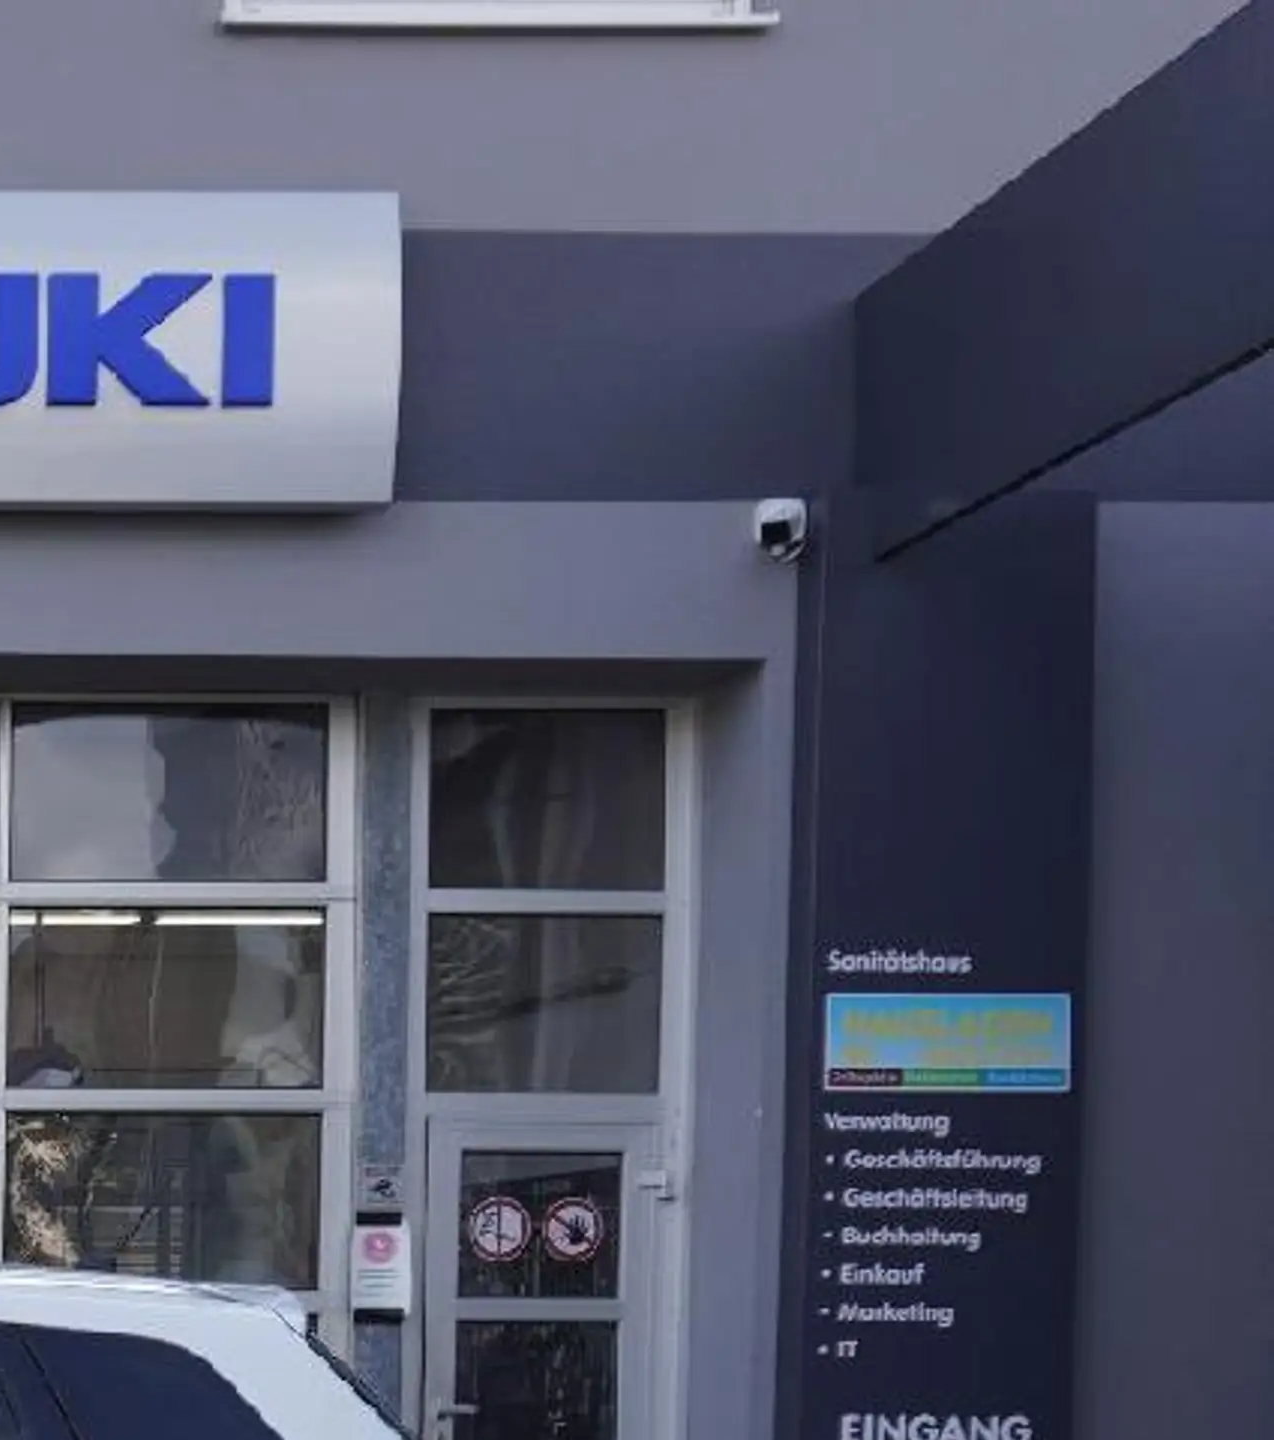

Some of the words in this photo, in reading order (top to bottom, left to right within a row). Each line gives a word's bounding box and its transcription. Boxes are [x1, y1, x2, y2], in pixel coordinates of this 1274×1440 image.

[827, 947, 973, 974] Sanitätshaus
[824, 1112, 951, 1136] Verwaltung
[843, 1148, 1042, 1174] Geschäftsführung
[843, 1187, 1029, 1213] Geschäftsleitung
[840, 1226, 982, 1252] Buchhaltung
[838, 1262, 926, 1285] Einkauf
[836, 1302, 955, 1327] Marketing
[836, 1340, 859, 1357] IT
